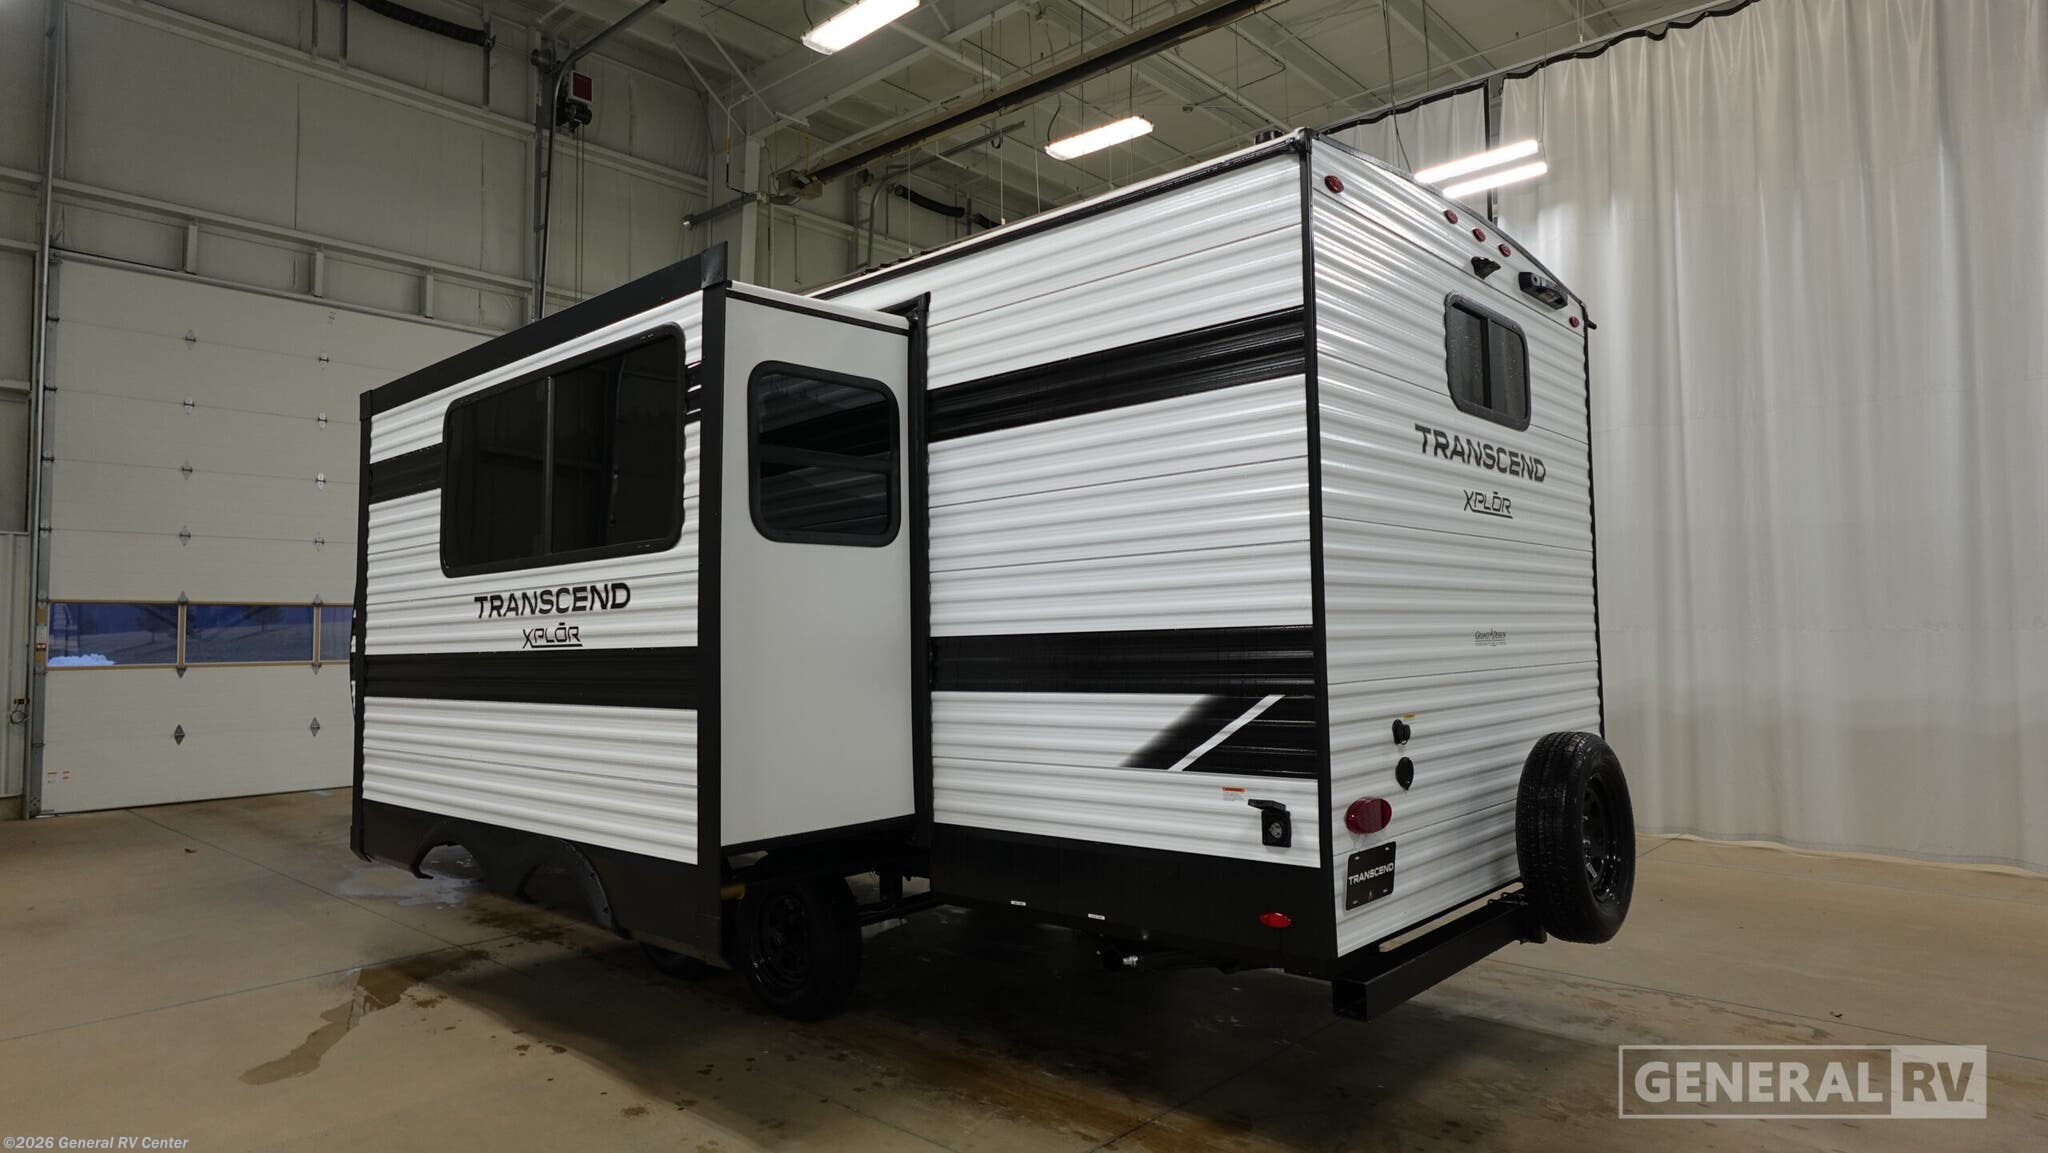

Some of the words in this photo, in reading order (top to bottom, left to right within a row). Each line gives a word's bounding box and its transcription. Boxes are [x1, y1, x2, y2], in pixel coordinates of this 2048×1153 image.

[1414, 423, 1546, 482] TRANSCEND
[474, 582, 631, 618] TRANSCEND
[1348, 862, 1394, 886] TRANSCEND
